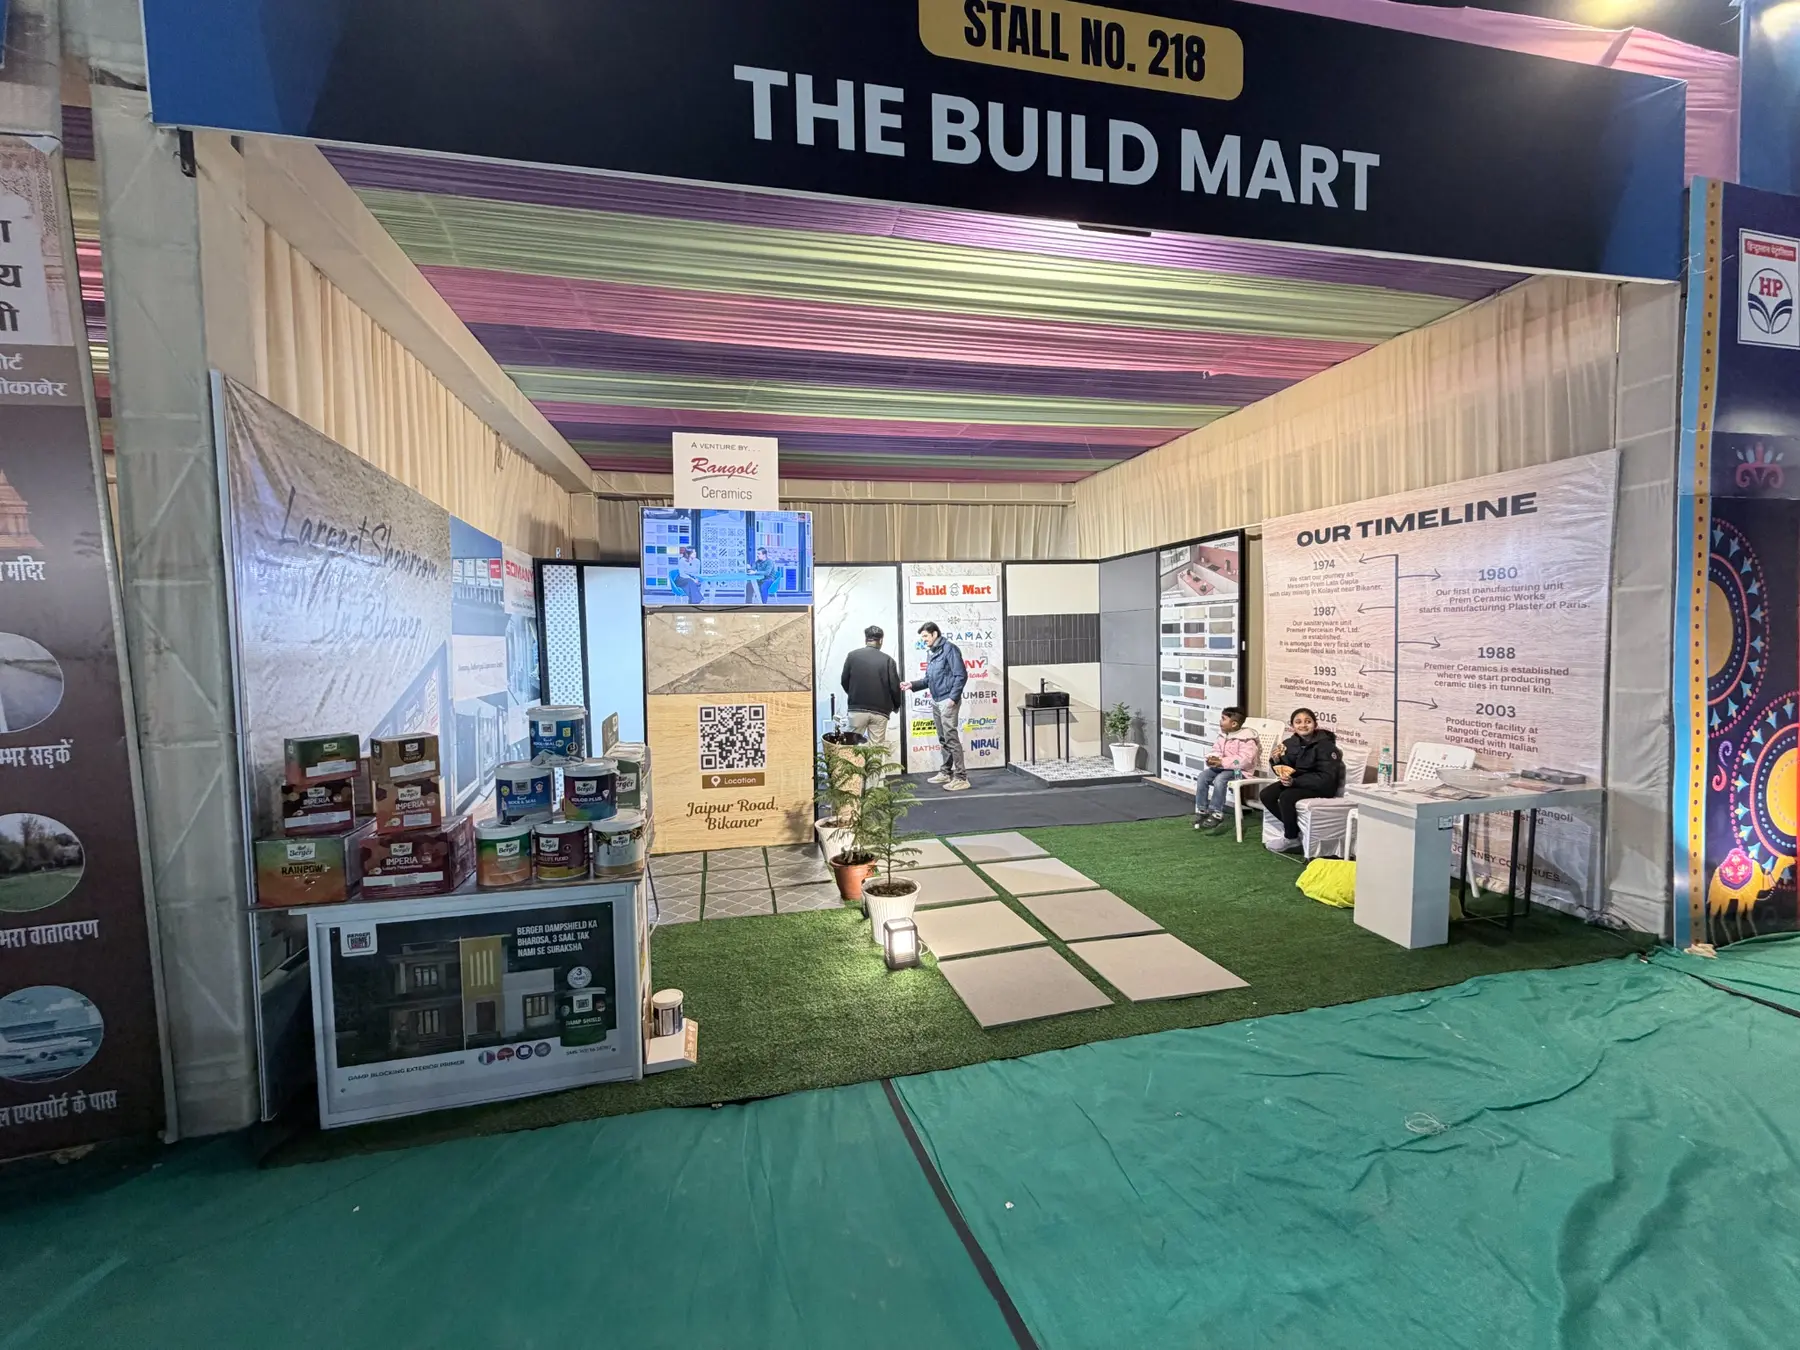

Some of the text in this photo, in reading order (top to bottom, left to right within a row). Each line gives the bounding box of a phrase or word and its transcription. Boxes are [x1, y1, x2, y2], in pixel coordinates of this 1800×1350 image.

[964, 0, 1205, 82] STALL NO. 218
[734, 65, 1380, 211] THE BUILD MART
[1759, 277, 1783, 297] HP
[691, 458, 758, 479] Rangoli
[702, 486, 752, 500] Ceramics
[1297, 492, 1537, 547] OUR TIMELINE
[1313, 560, 1335, 570] 1974
[1479, 567, 1517, 581] 1980
[916, 585, 991, 595] Build Mart
[1472, 583, 1540, 594] manufacturing
[1543, 582, 1564, 590] unit
[1449, 593, 1546, 604] Prem Ceramic Works
[1314, 607, 1336, 616] 1987
[1443, 603, 1505, 613] manufacturing
[1508, 602, 1543, 611] Plaster
[1559, 601, 1590, 609] Paris.
[1477, 647, 1516, 659] 1988
[1314, 666, 1336, 676] 1993
[1424, 663, 1569, 676] Premier Ceramics is established
[1434, 680, 1466, 688] ceramic
[1469, 681, 1487, 689] tiles
[1500, 684, 1530, 693] tunnel
[1533, 686, 1554, 694] kiln.
[1501, 676, 1551, 686] producing
[1476, 703, 1516, 718] 2003
[1446, 717, 1492, 728] Production
[1495, 722, 1526, 735] facility
[1447, 726, 1536, 743] Rangoli Ceramics is
[1445, 735, 1538, 753] upgraded with Italian
[724, 777, 756, 785] Location
[396, 800, 424, 810] IMPERIA
[686, 802, 733, 818] Jaipur
[705, 817, 762, 830] Bikaner
[386, 857, 417, 865] IMPERIA
[28, 919, 99, 945] वातावरण
[517, 920, 597, 936] BERGER DAMPSHIELD KA
[559, 933, 575, 942] SAAL
[577, 931, 590, 939] TAK
[518, 943, 582, 957] NAMI SE SURAKSHA
[577, 968, 582, 976] 3
[370, 1069, 404, 1078] BLOCKING
[406, 1063, 438, 1072] EXTERIOR
[12, 1090, 117, 1124] एयरपोर्ट के पास
